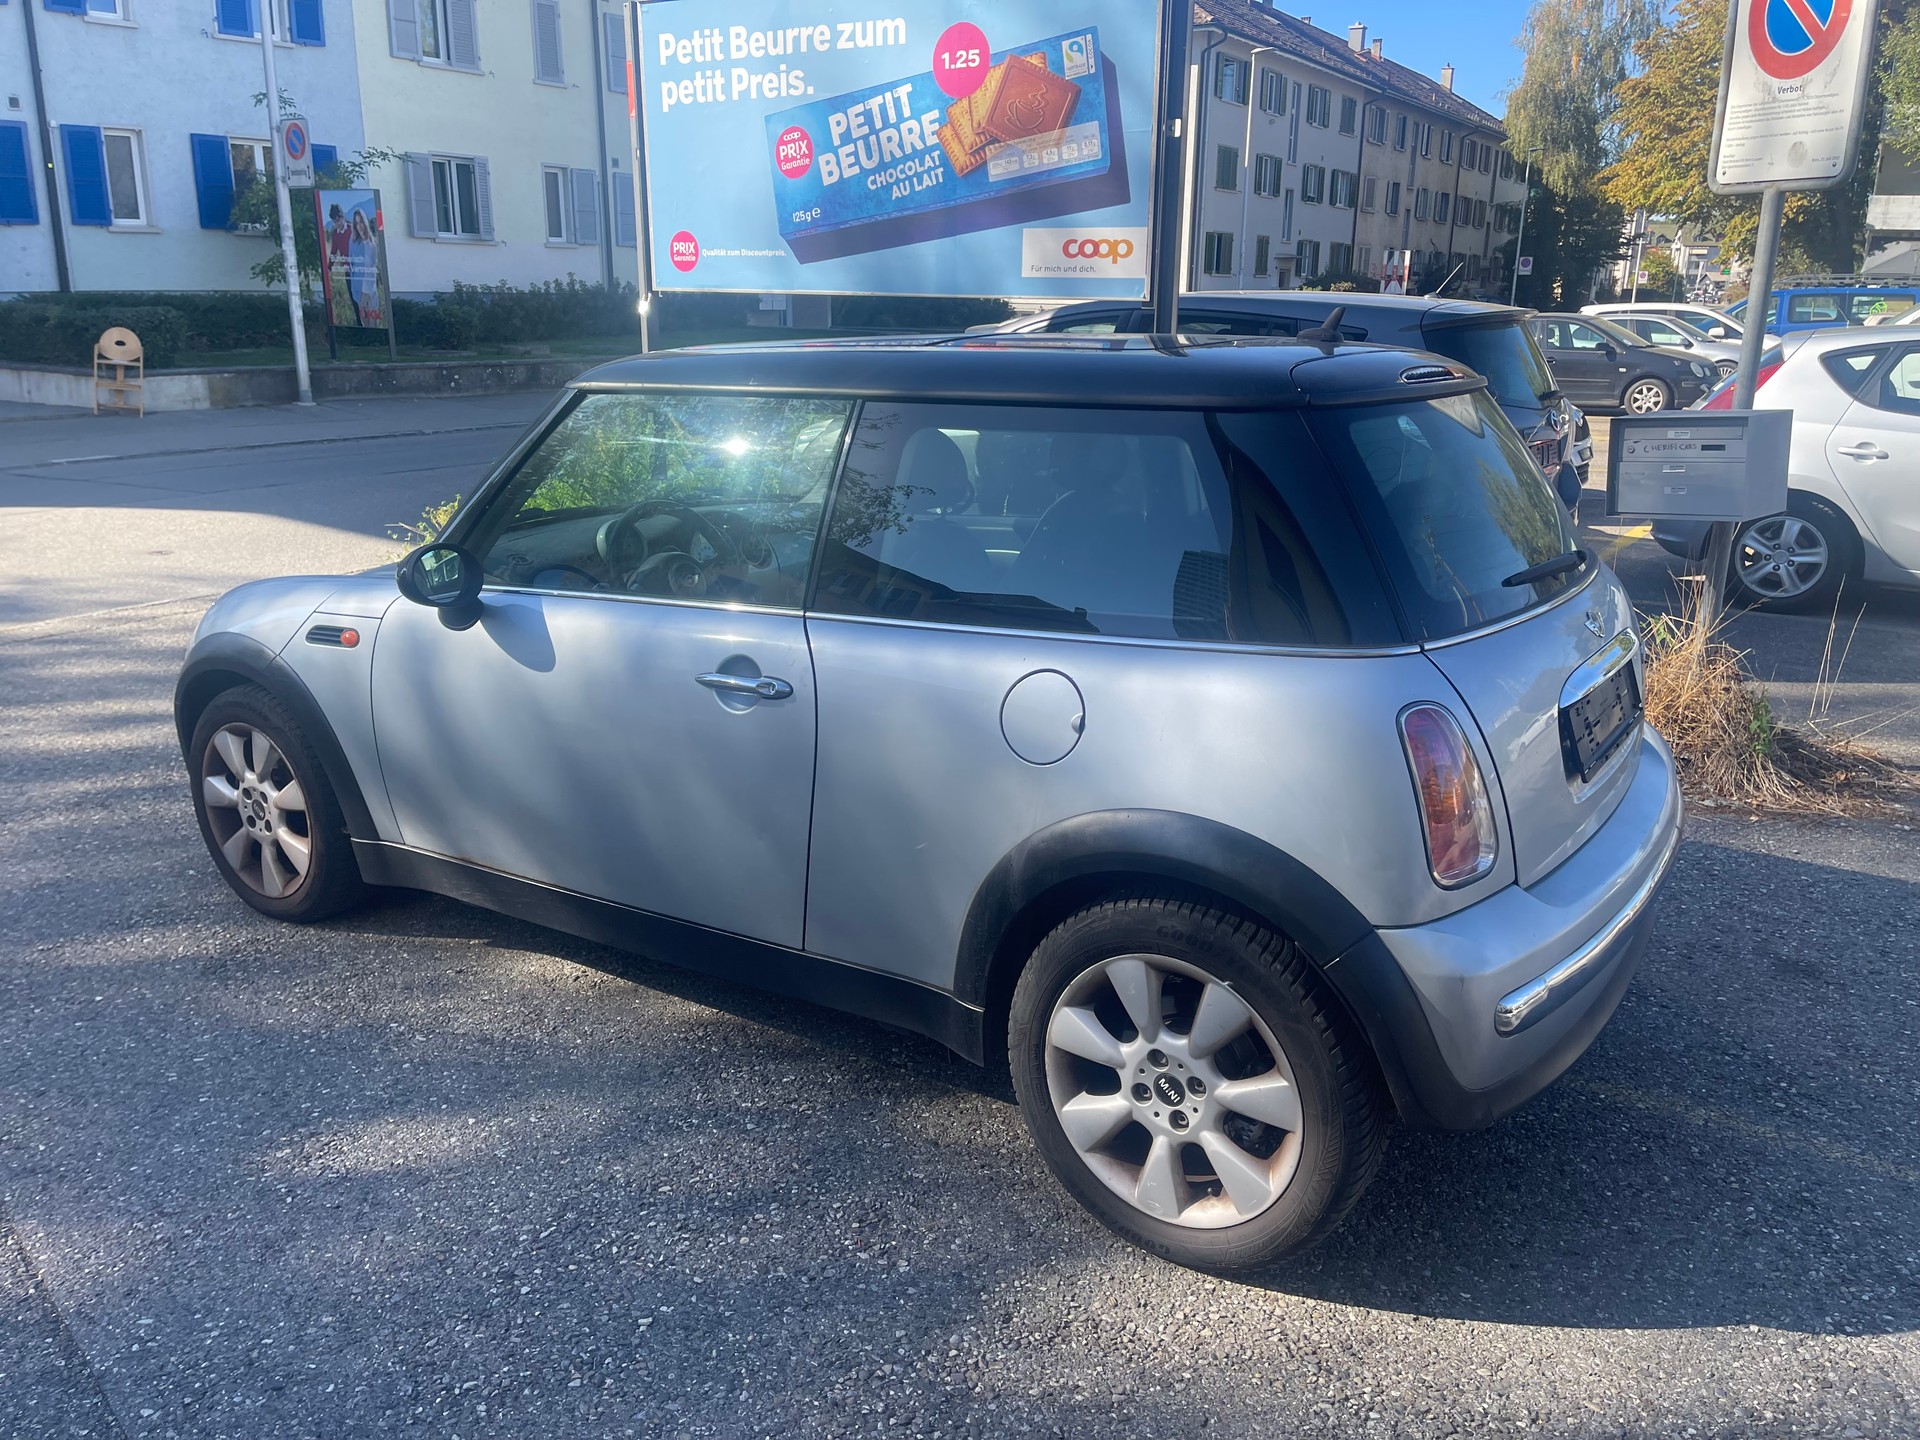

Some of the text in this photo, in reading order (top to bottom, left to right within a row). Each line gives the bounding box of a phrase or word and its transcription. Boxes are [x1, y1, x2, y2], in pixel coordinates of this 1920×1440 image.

[659, 17, 906, 65] Petit Beurre zum
[941, 49, 980, 70] 1.25
[661, 64, 814, 112] petit Preis.
[1777, 84, 1803, 95] Verbot
[828, 83, 912, 146] PETIT
[818, 109, 940, 186] BEURRE
[781, 157, 810, 171] Garantie
[867, 150, 941, 190] CHOCOLAT
[892, 167, 944, 200] AU LAIT
[673, 254, 696, 262] Garantie
[702, 248, 726, 257] Qualität
[1062, 239, 1134, 265] coop
[1031, 264, 1042, 272] Für
[1044, 264, 1061, 272] mich
[1063, 264, 1077, 272] und
[1679, 443, 1697, 451] CARS
[1158, 1077, 1181, 1103] MINI
